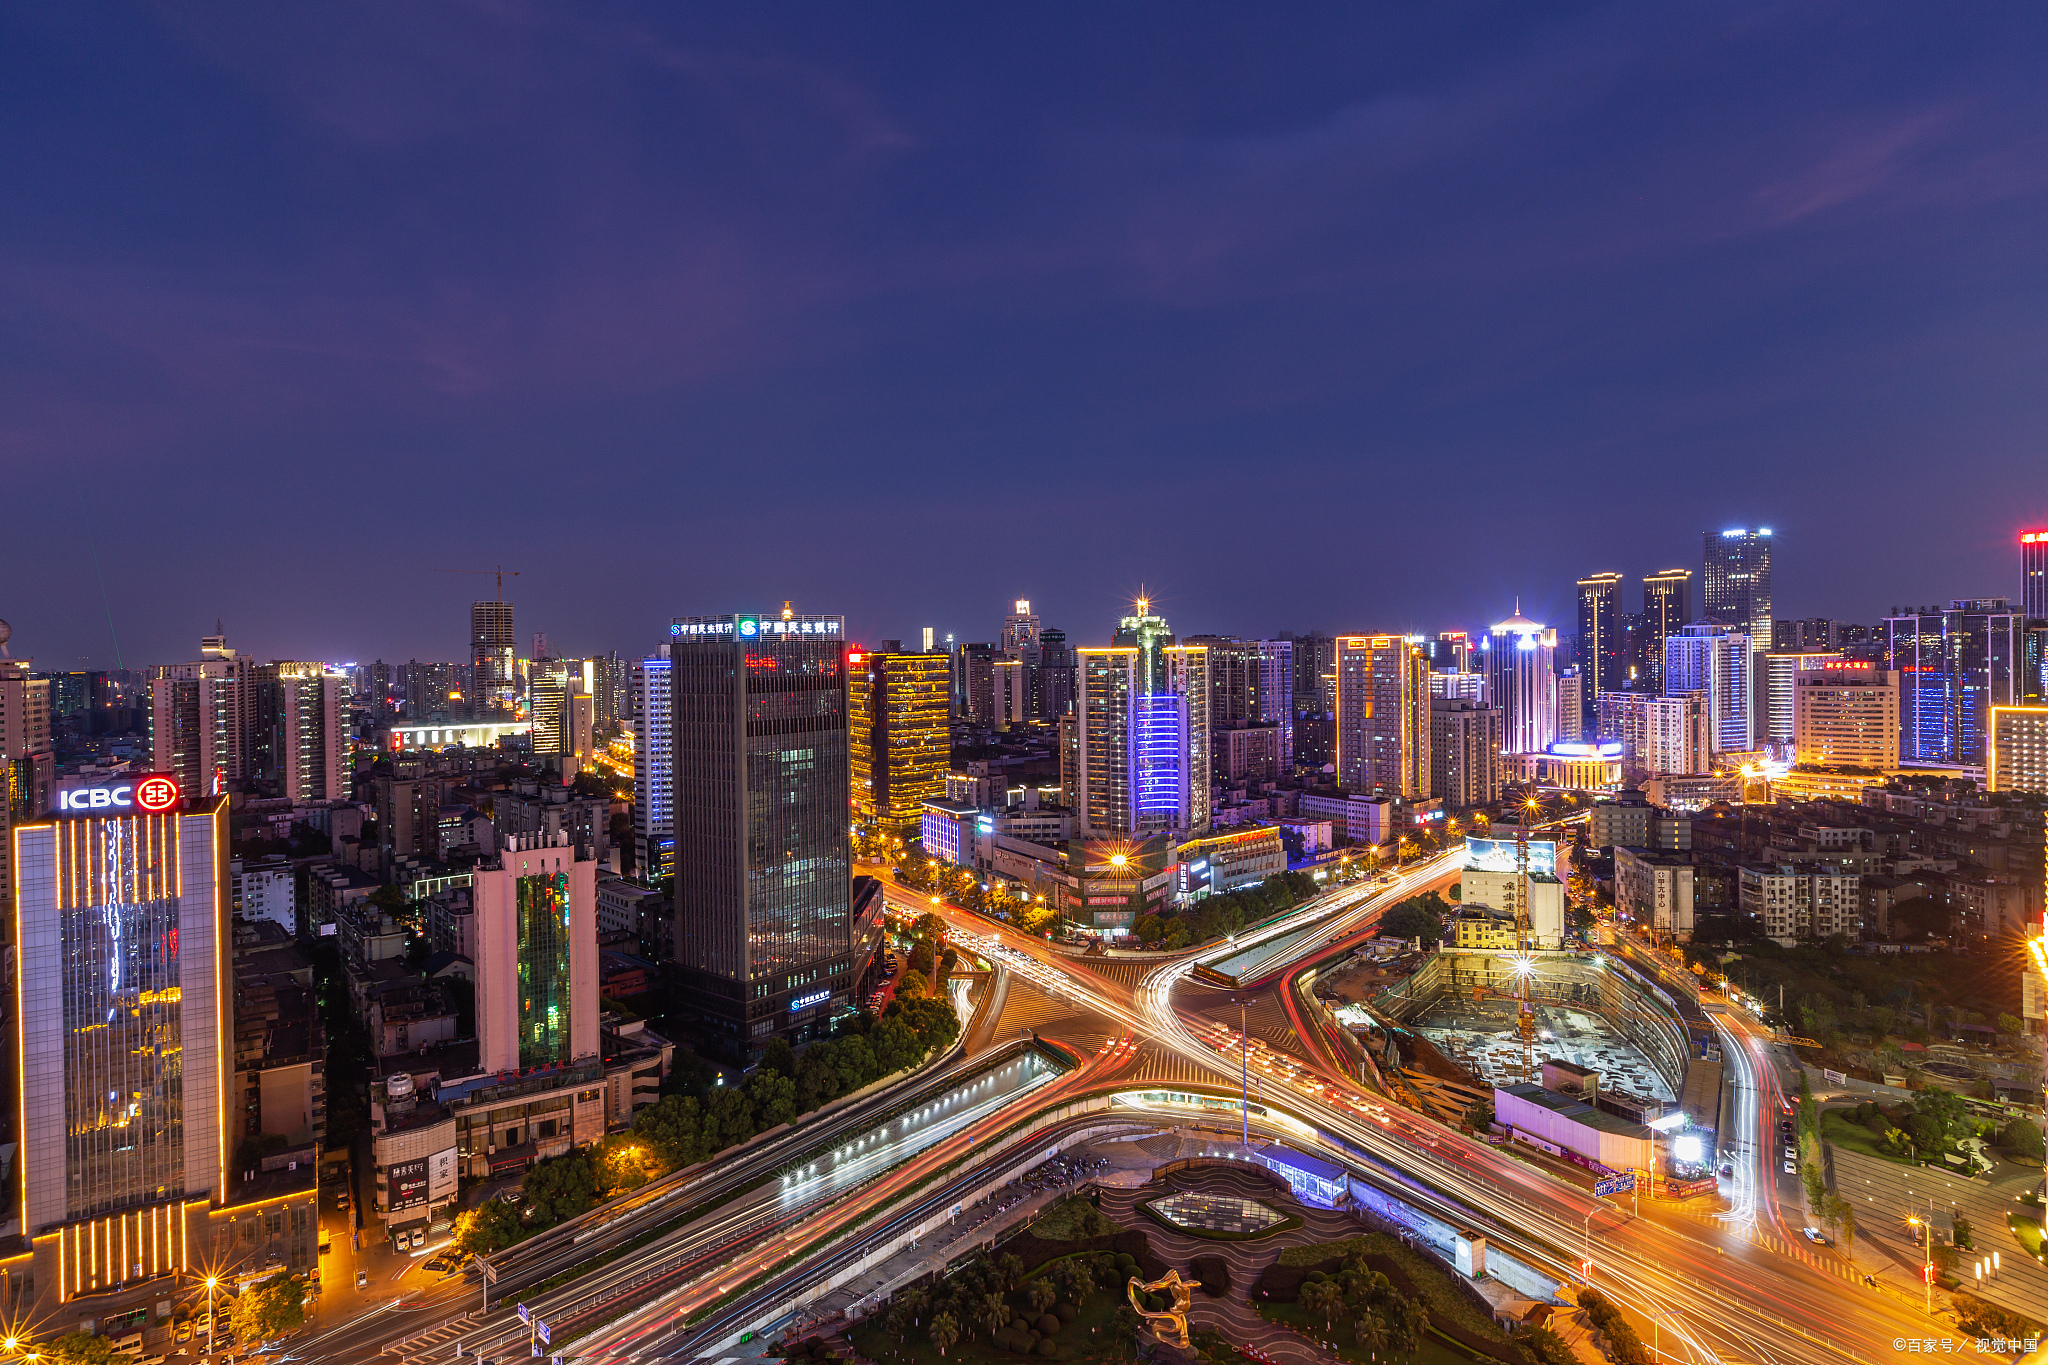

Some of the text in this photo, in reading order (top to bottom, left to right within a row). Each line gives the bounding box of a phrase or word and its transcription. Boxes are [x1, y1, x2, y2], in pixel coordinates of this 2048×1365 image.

[680, 622, 734, 635] 中国民生银行
[760, 621, 839, 634] 中国民生银行
[1826, 661, 1869, 670] 新华大酒店
[61, 786, 131, 810] ICBC
